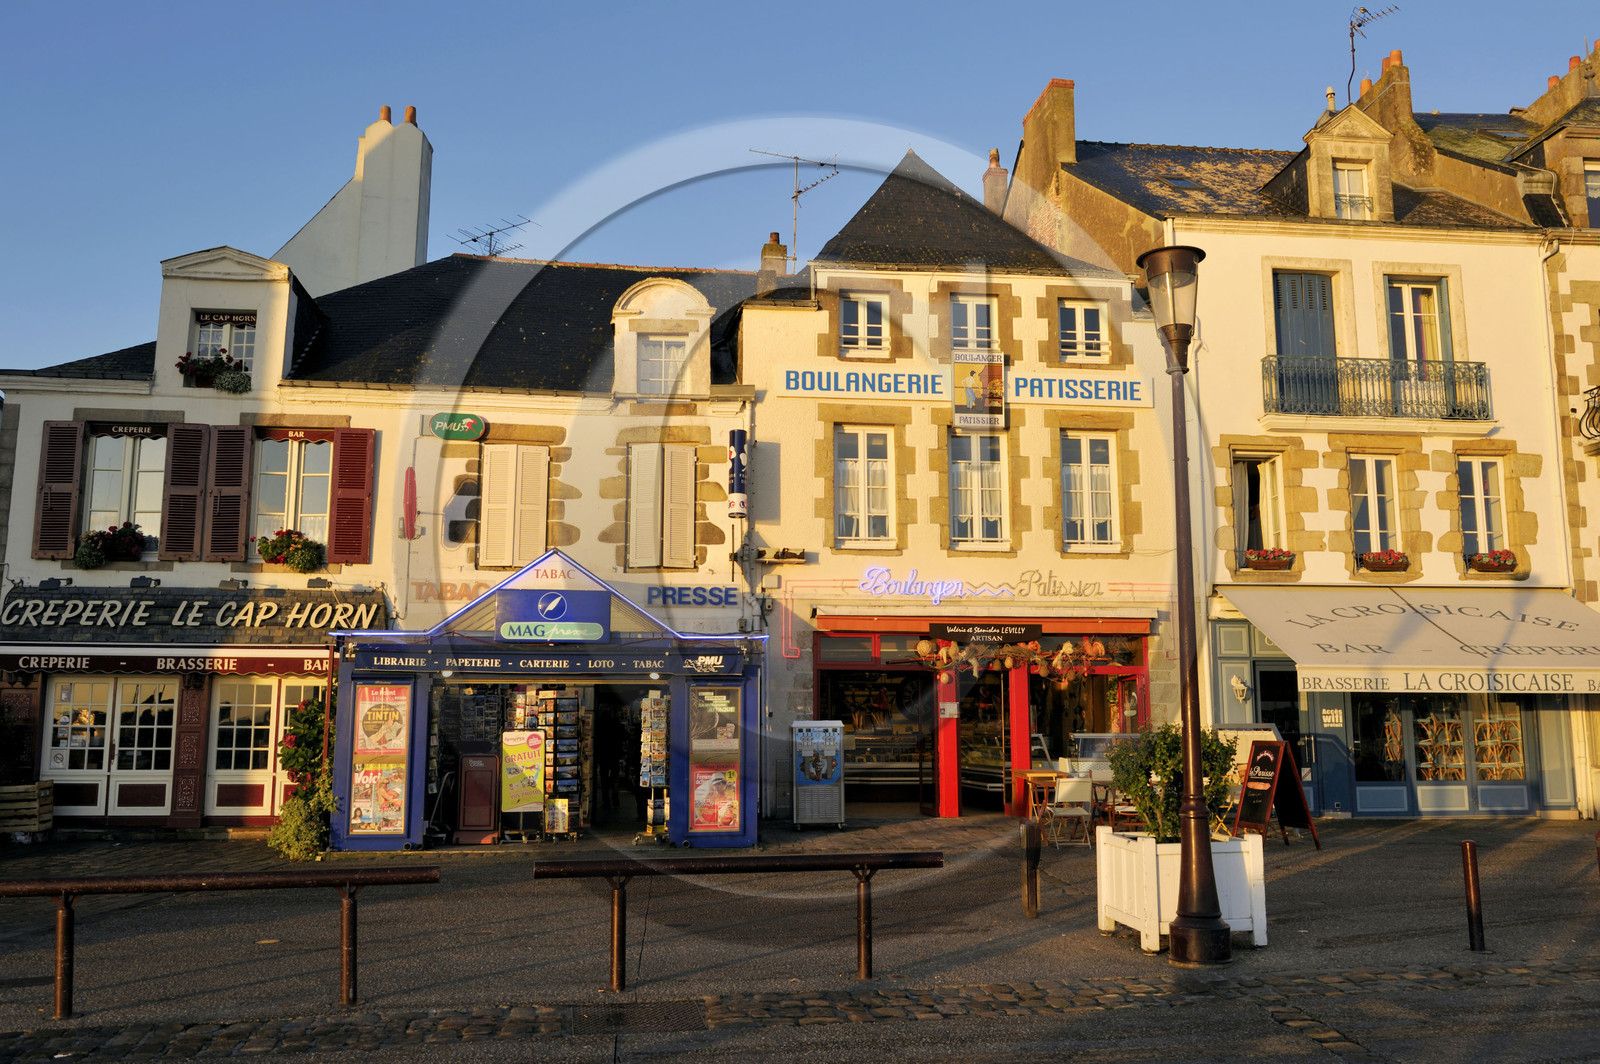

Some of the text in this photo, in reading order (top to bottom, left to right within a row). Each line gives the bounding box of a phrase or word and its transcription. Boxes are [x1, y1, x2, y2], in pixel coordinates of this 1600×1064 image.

[199, 313, 256, 322] LE CAP HORN
[954, 353, 1003, 363] BOULANGER
[785, 370, 943, 394] BOULANGERIE
[1014, 377, 1142, 401] PATISSERIE
[435, 421, 461, 431] PMU
[958, 416, 1000, 426] PATISSIER
[111, 424, 152, 434] CREPERIE
[287, 430, 305, 438] BAR
[534, 569, 576, 580] TABAC
[411, 582, 489, 600] TABAC
[859, 567, 1104, 606] Boulanger Patissier
[647, 586, 738, 606] PRESSE
[1, 599, 378, 629] CREPERIE LE CAP HORN
[1286, 602, 1580, 632] LA CROISICAISE
[508, 623, 599, 642] MAG presse
[1312, 643, 1394, 654] BAR
[19, 656, 90, 669] CREPERIE
[156, 658, 237, 671] BRASSERIE
[373, 657, 426, 667] LIBRAIRIE
[445, 658, 501, 668] PAPETERIE
[519, 659, 569, 669] CARTERIE
[588, 660, 614, 669] LOTO
[632, 660, 664, 669] TABAC
[697, 655, 723, 665] PMU
[1301, 677, 1390, 691] BRASSERIE
[1404, 673, 1433, 691] LA
[1438, 673, 1575, 692] CROISICAISE
[367, 711, 400, 721] TINTIN
[504, 749, 540, 763] GRATUIT
